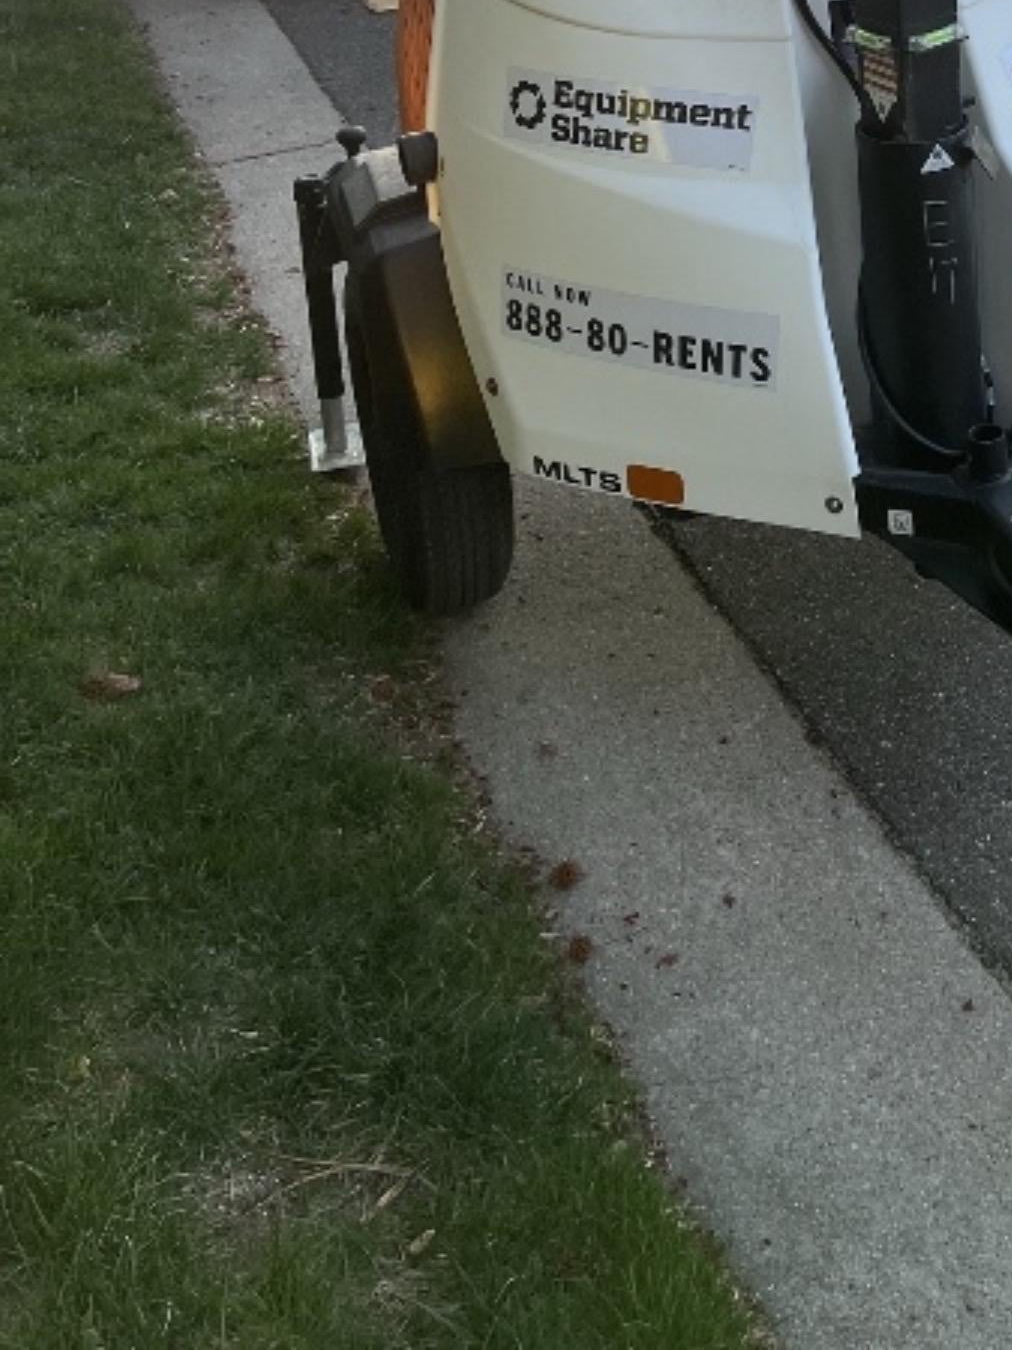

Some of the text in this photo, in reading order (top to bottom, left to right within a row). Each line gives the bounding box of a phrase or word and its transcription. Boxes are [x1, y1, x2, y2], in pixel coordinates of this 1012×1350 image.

[553, 79, 752, 131] Equipment
[551, 113, 648, 153] Share
[505, 272, 592, 306] CALL NOW
[505, 298, 771, 382] 888-80-RENTS
